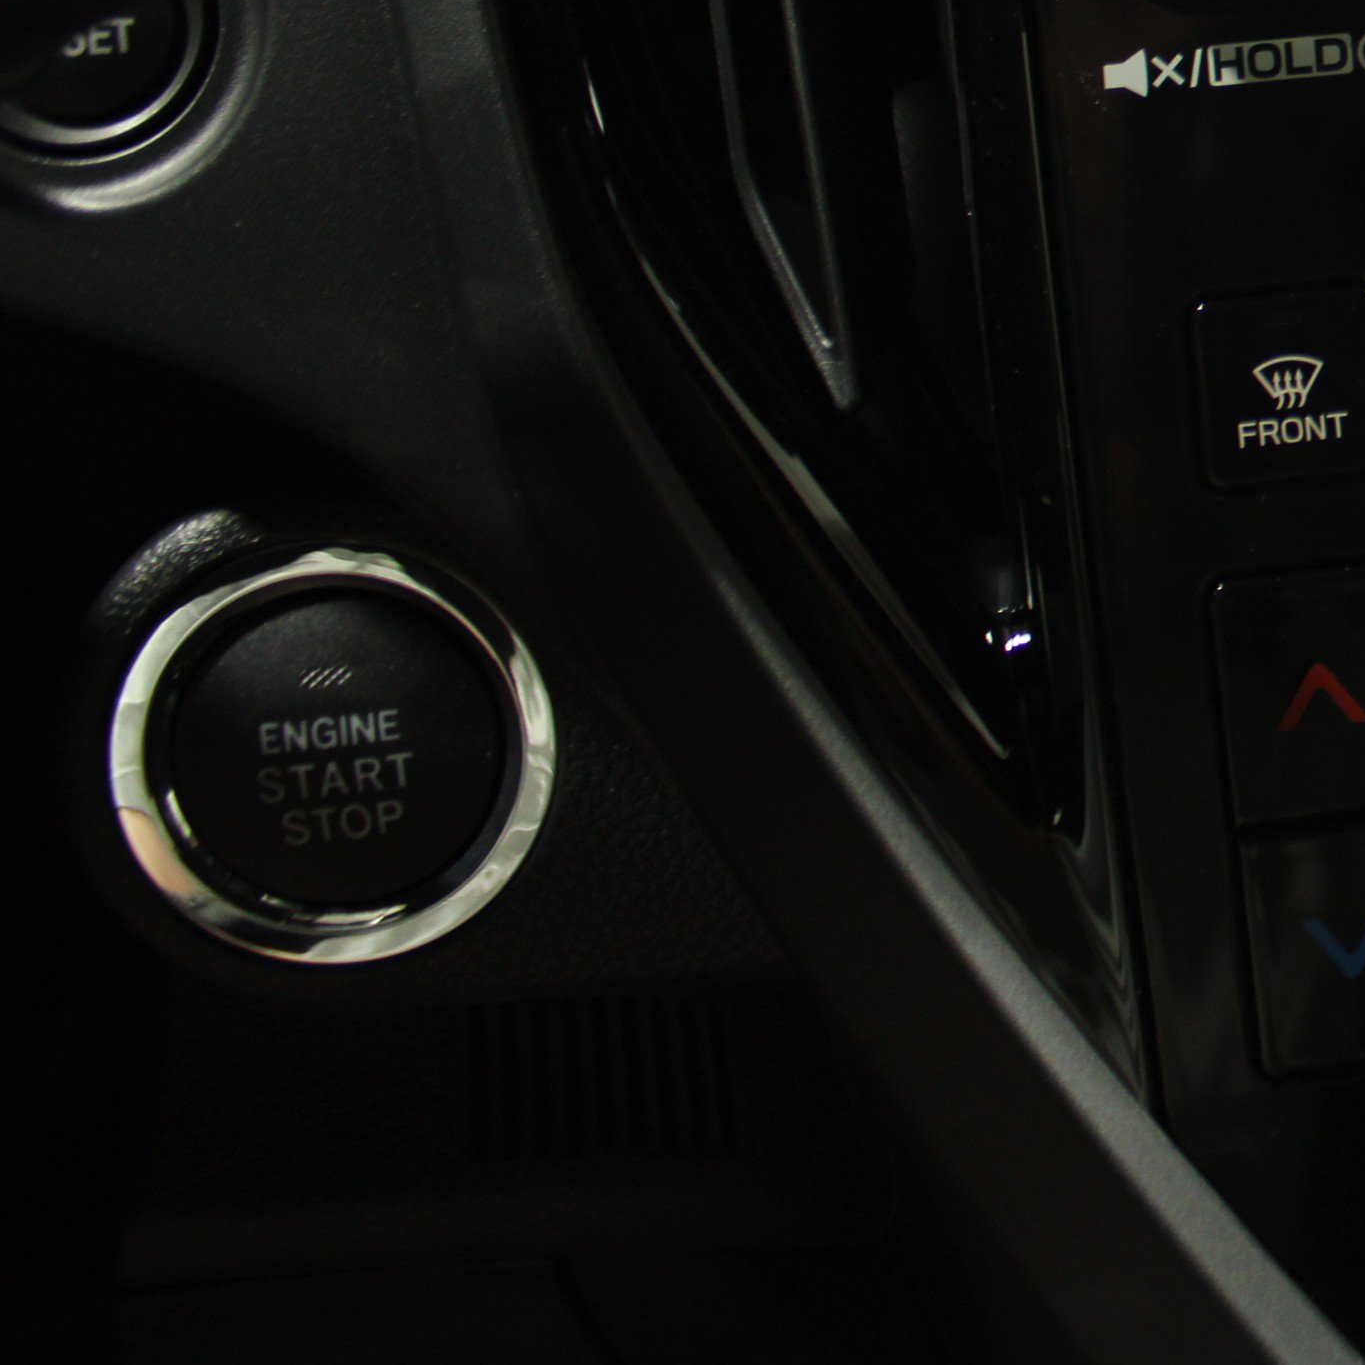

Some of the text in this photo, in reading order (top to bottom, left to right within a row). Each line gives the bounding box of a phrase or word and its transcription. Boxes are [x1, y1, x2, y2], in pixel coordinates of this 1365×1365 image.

[1237, 411, 1349, 449] FRONT
[259, 709, 401, 755] ENGINE
[256, 752, 412, 805] START
[281, 801, 404, 847] STOP
